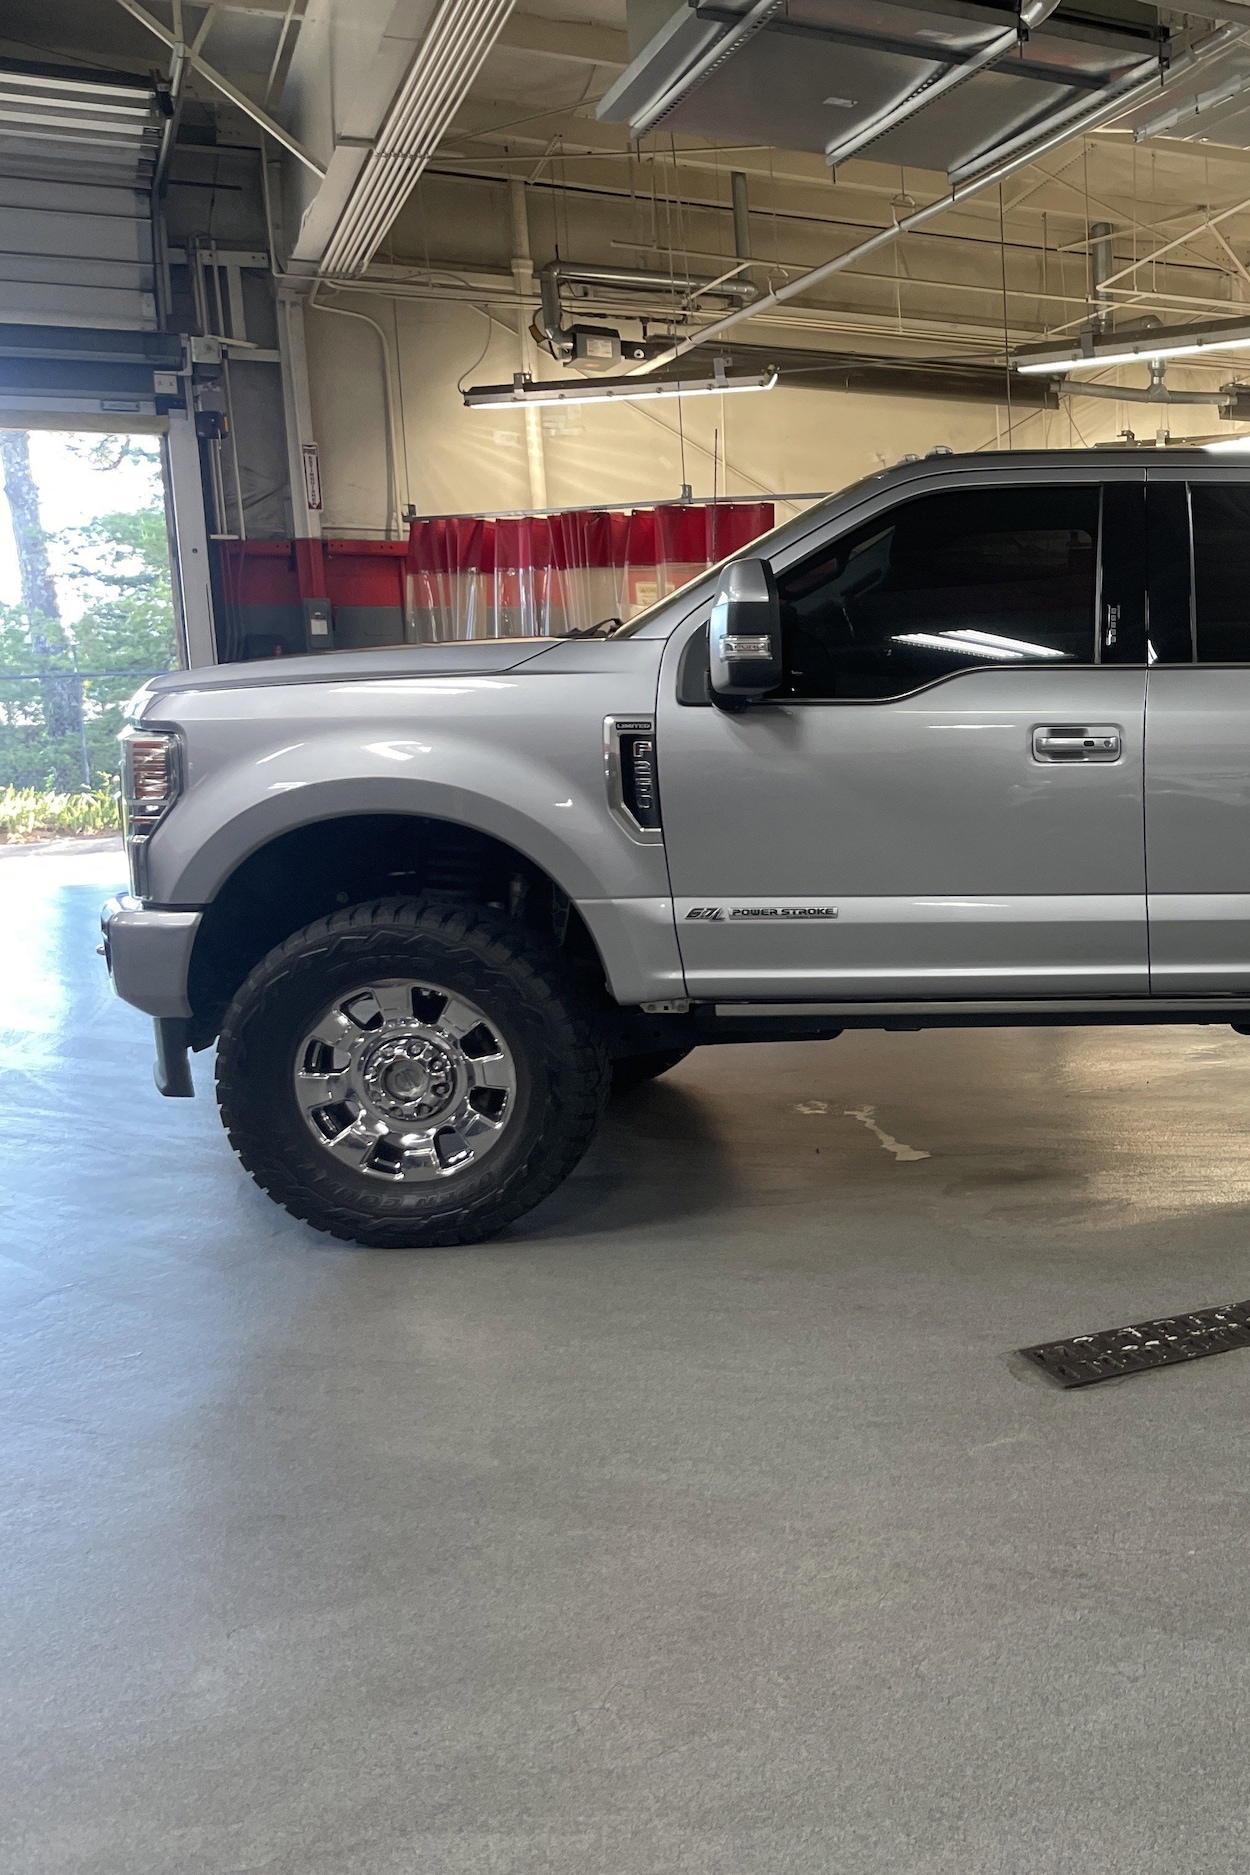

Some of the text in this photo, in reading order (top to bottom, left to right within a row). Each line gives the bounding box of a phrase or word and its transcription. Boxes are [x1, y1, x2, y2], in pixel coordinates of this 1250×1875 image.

[616, 722, 652, 730] LIMITED
[732, 908, 834, 917] POWER STROKE
